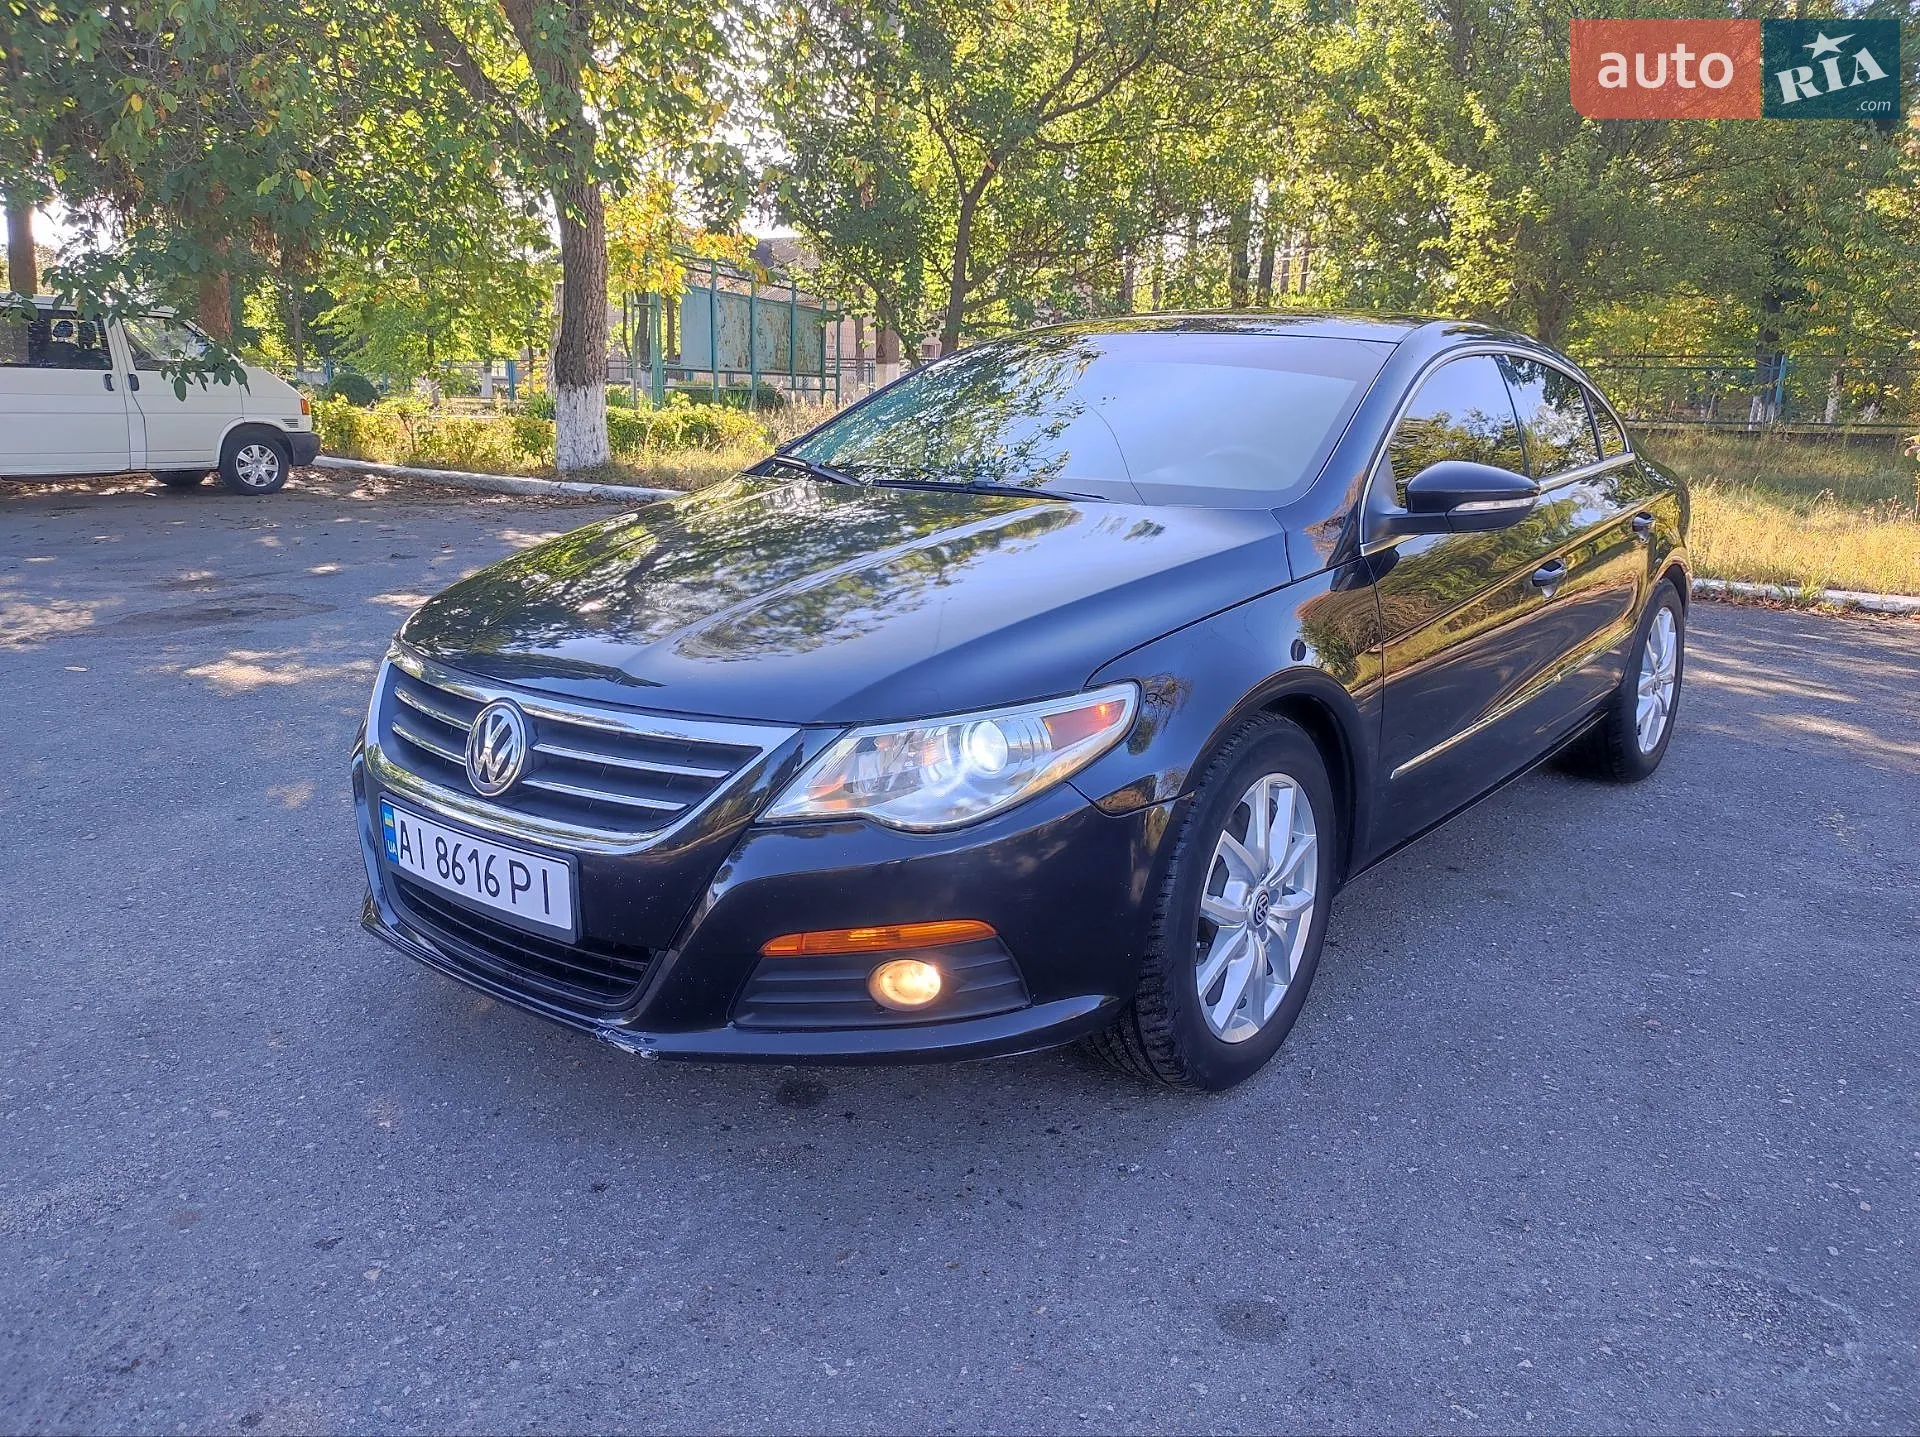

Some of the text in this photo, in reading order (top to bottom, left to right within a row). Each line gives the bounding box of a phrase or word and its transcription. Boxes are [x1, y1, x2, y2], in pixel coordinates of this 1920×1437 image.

[387, 841, 398, 856] UA
[400, 820, 550, 915] AI 8616 PI
